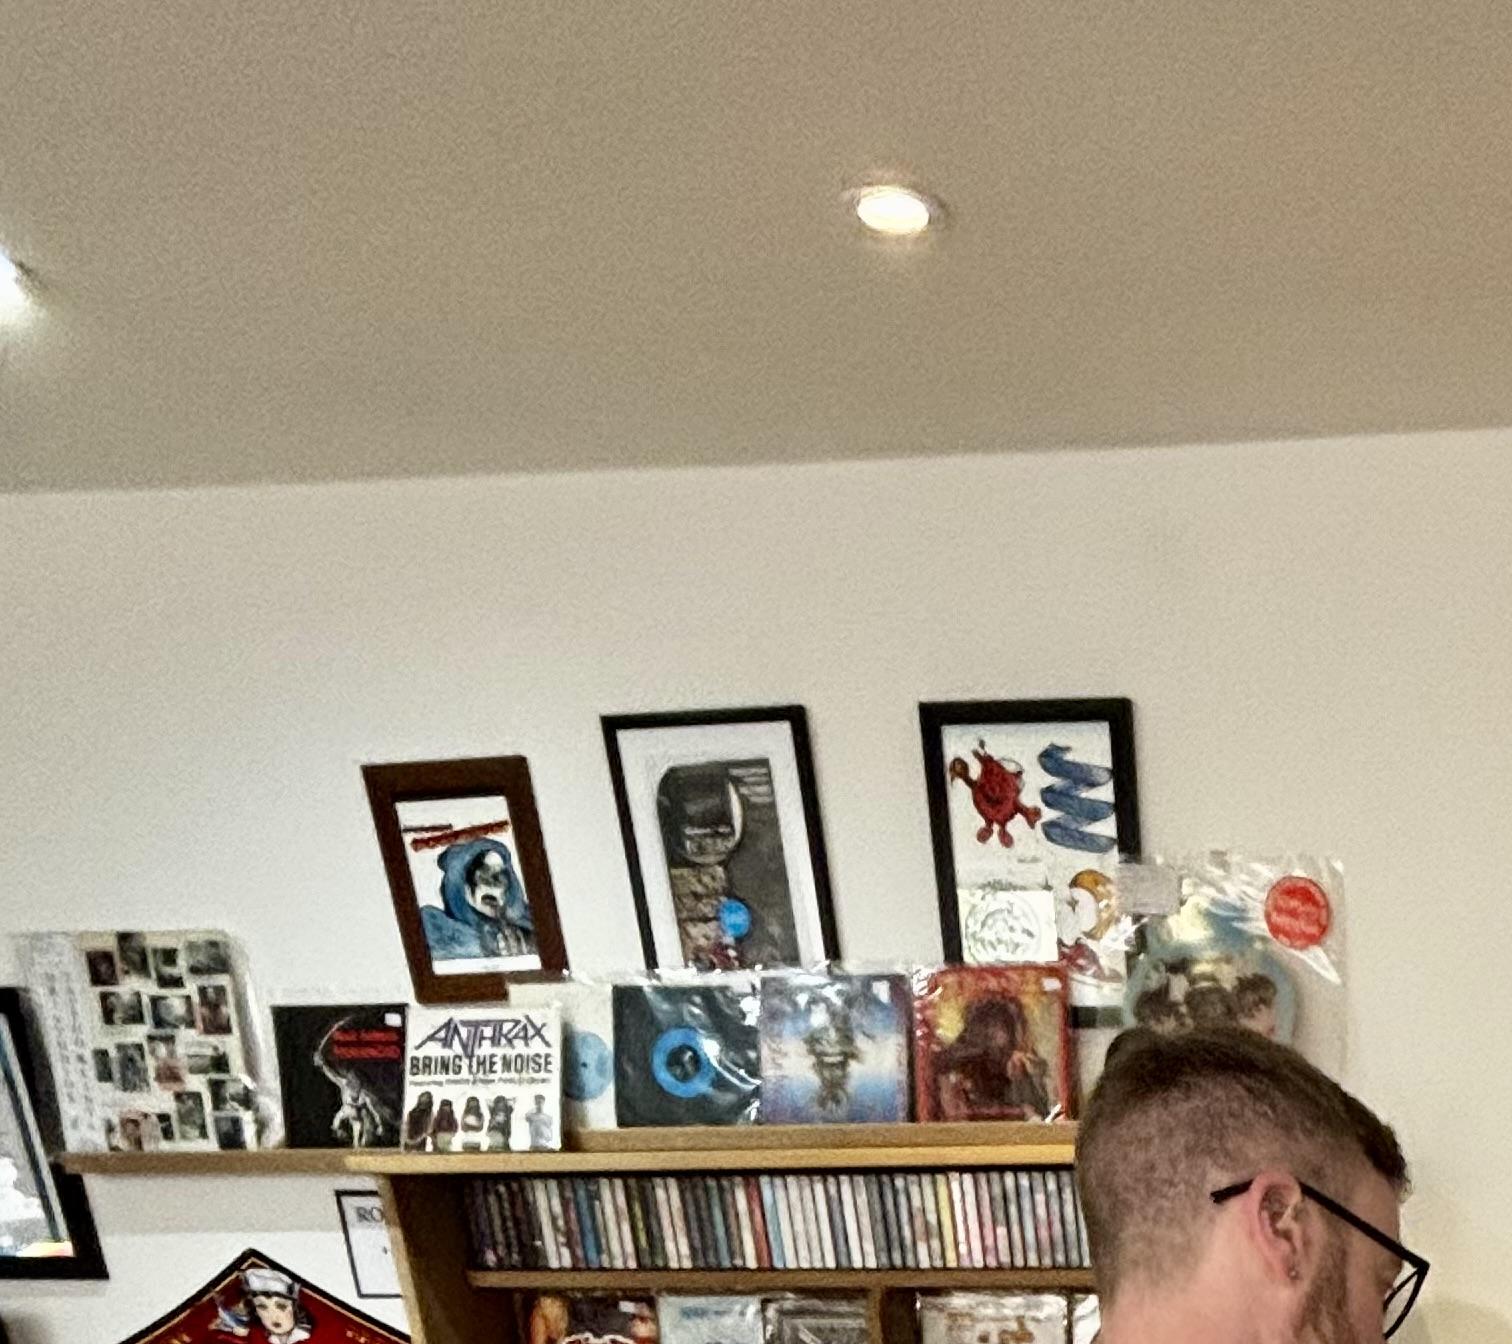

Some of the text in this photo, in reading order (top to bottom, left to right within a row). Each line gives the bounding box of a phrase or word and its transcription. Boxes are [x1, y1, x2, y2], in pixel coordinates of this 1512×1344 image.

[414, 1014, 552, 1058] ANTHRAX
[409, 1052, 553, 1076] BRING THE NOISE
[357, 1206, 384, 1223] RO
